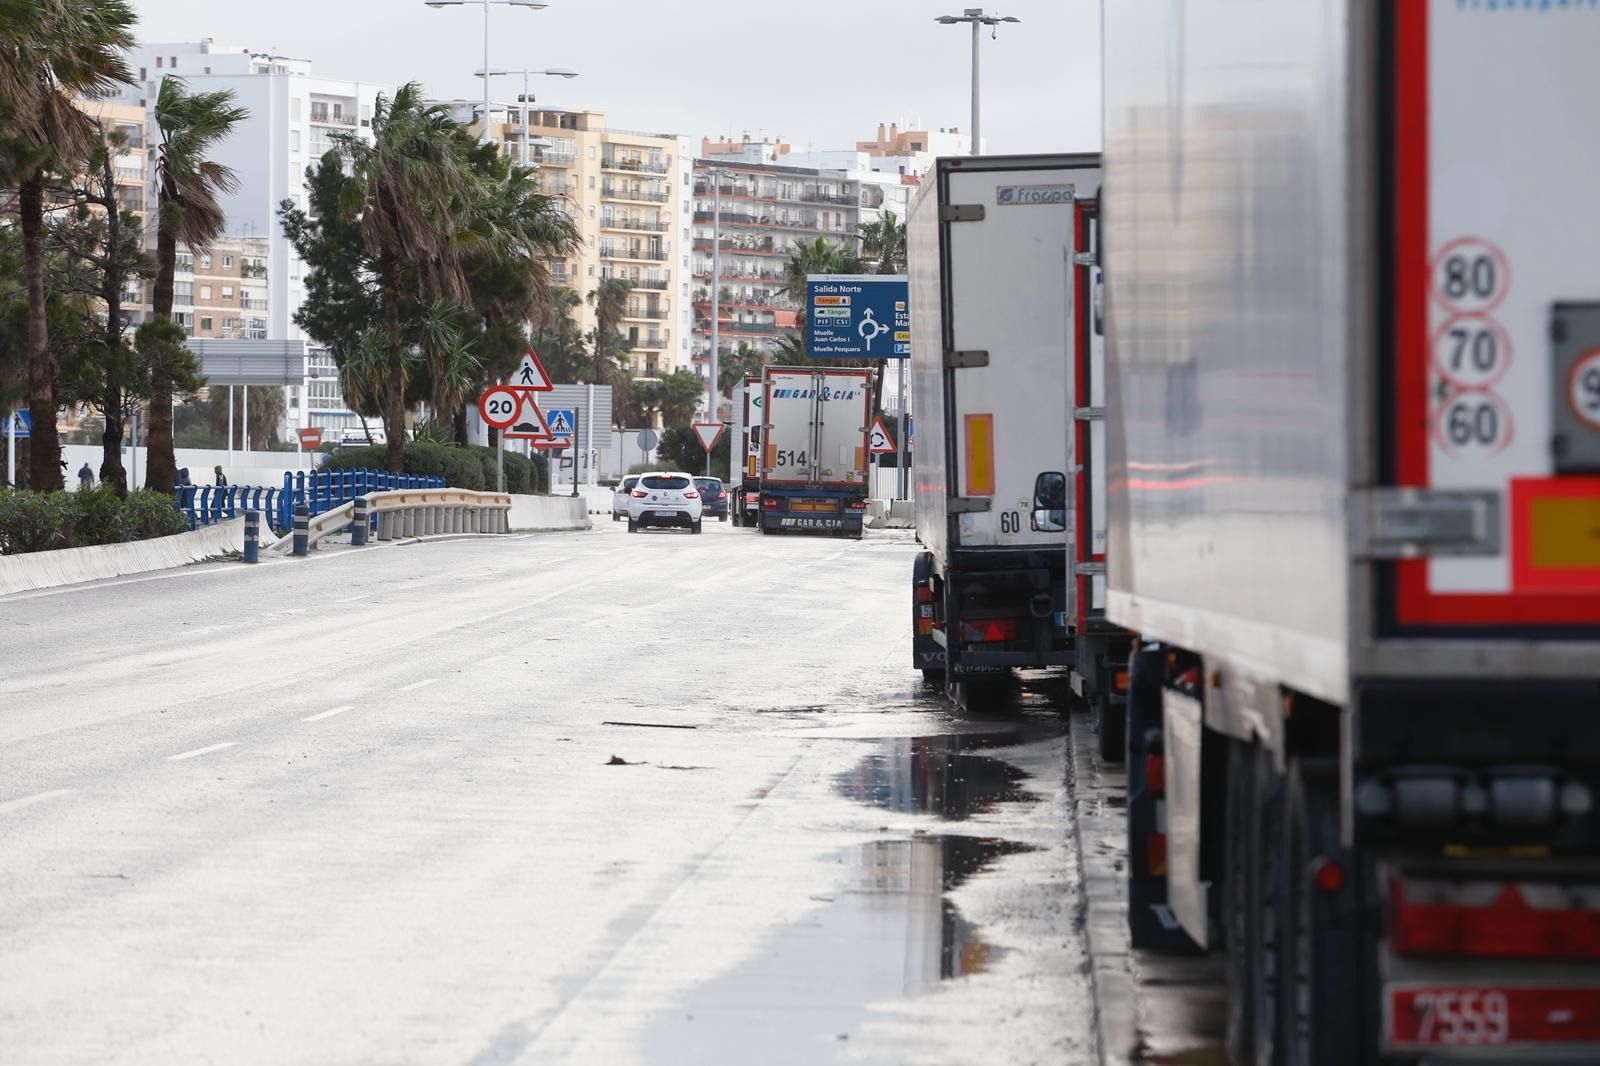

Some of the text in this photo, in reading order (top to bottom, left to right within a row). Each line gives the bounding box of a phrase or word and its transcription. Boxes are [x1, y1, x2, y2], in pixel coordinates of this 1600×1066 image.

[1444, 255, 1495, 299] 80
[814, 285, 862, 293] Salida Norte
[1449, 328, 1497, 372] 70
[818, 386, 831, 401] &
[833, 390, 854, 400] CIA
[489, 400, 513, 415] 20
[1448, 402, 1498, 446] 60
[777, 450, 807, 467] 514
[815, 519, 823, 527] &
[825, 519, 842, 527] CIA
[1001, 511, 1020, 533] 60
